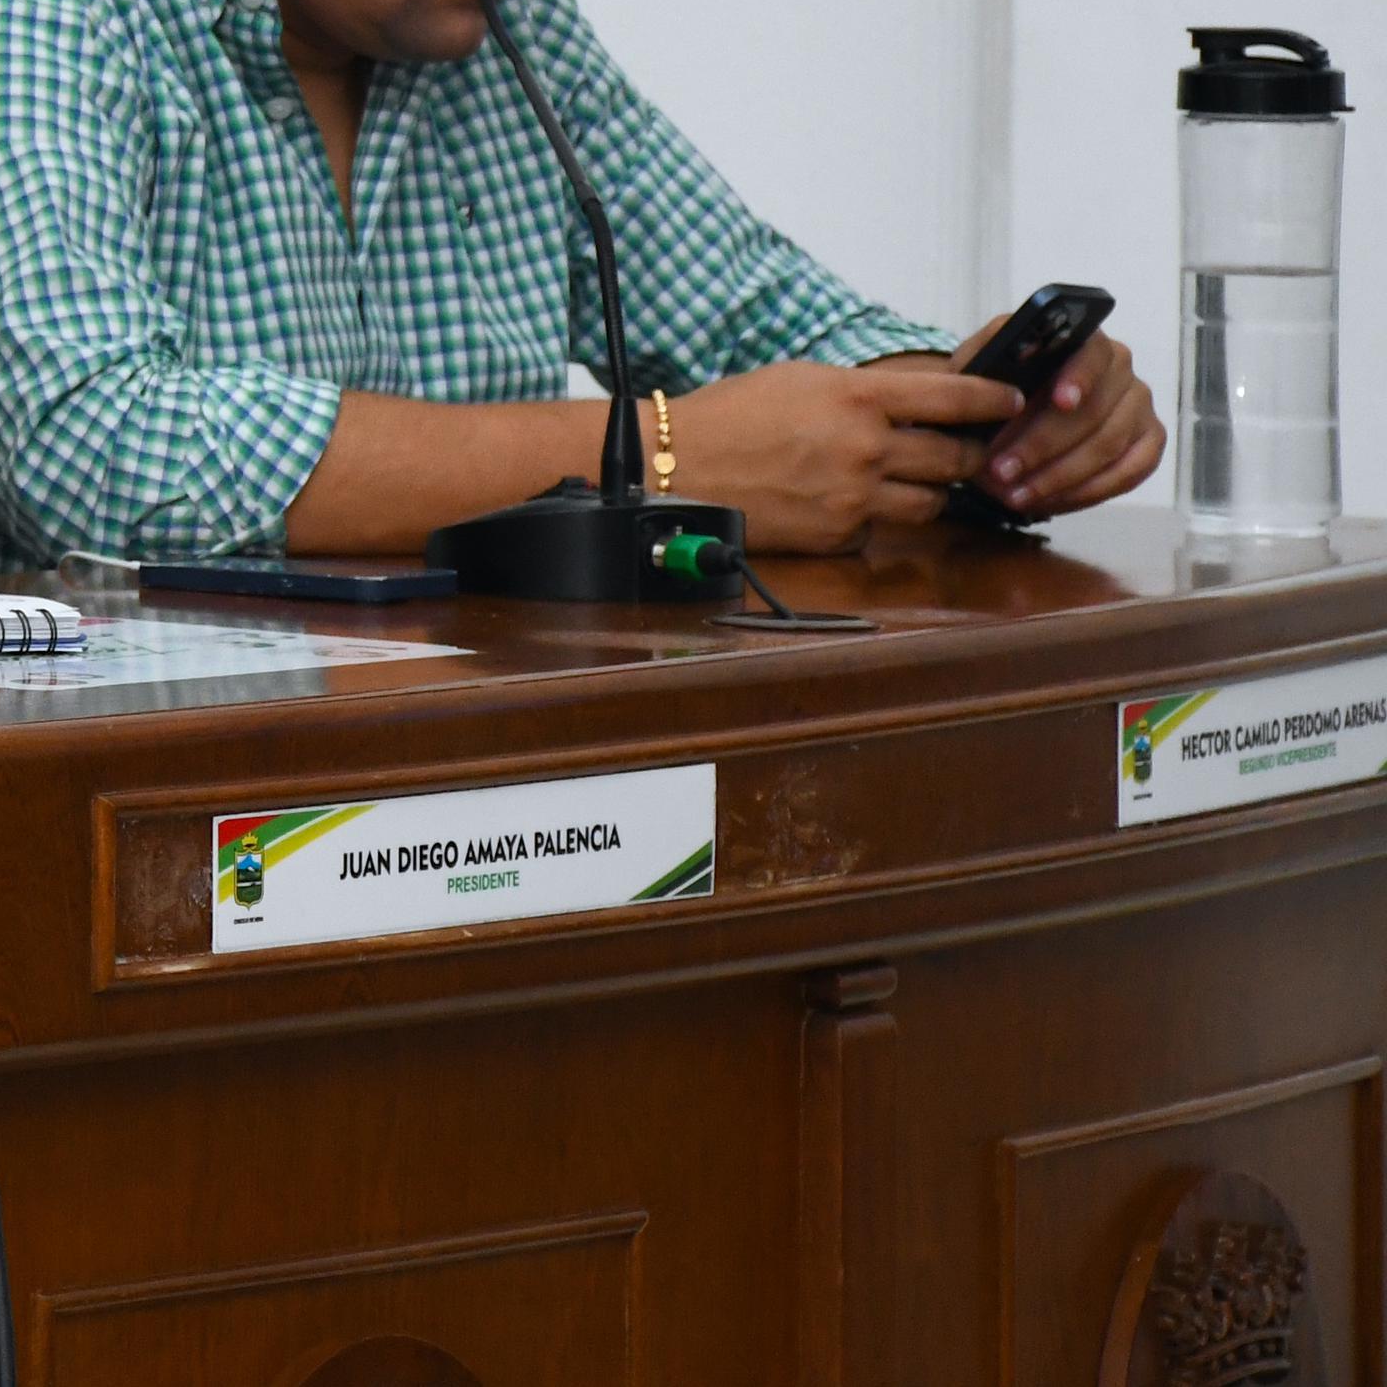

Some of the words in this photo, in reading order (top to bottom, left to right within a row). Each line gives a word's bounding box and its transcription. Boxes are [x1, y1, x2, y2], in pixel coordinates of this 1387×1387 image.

[1181, 729, 1232, 761] HECTOR
[1235, 719, 1281, 752] CAMILO
[1284, 707, 1342, 742] PERDOMO
[339, 848, 391, 881] JUAN
[398, 840, 459, 873] DIEGO
[464, 834, 529, 866] AMAYA
[534, 824, 621, 858] PALENCIA
[447, 870, 520, 894] PRESIDENTE
